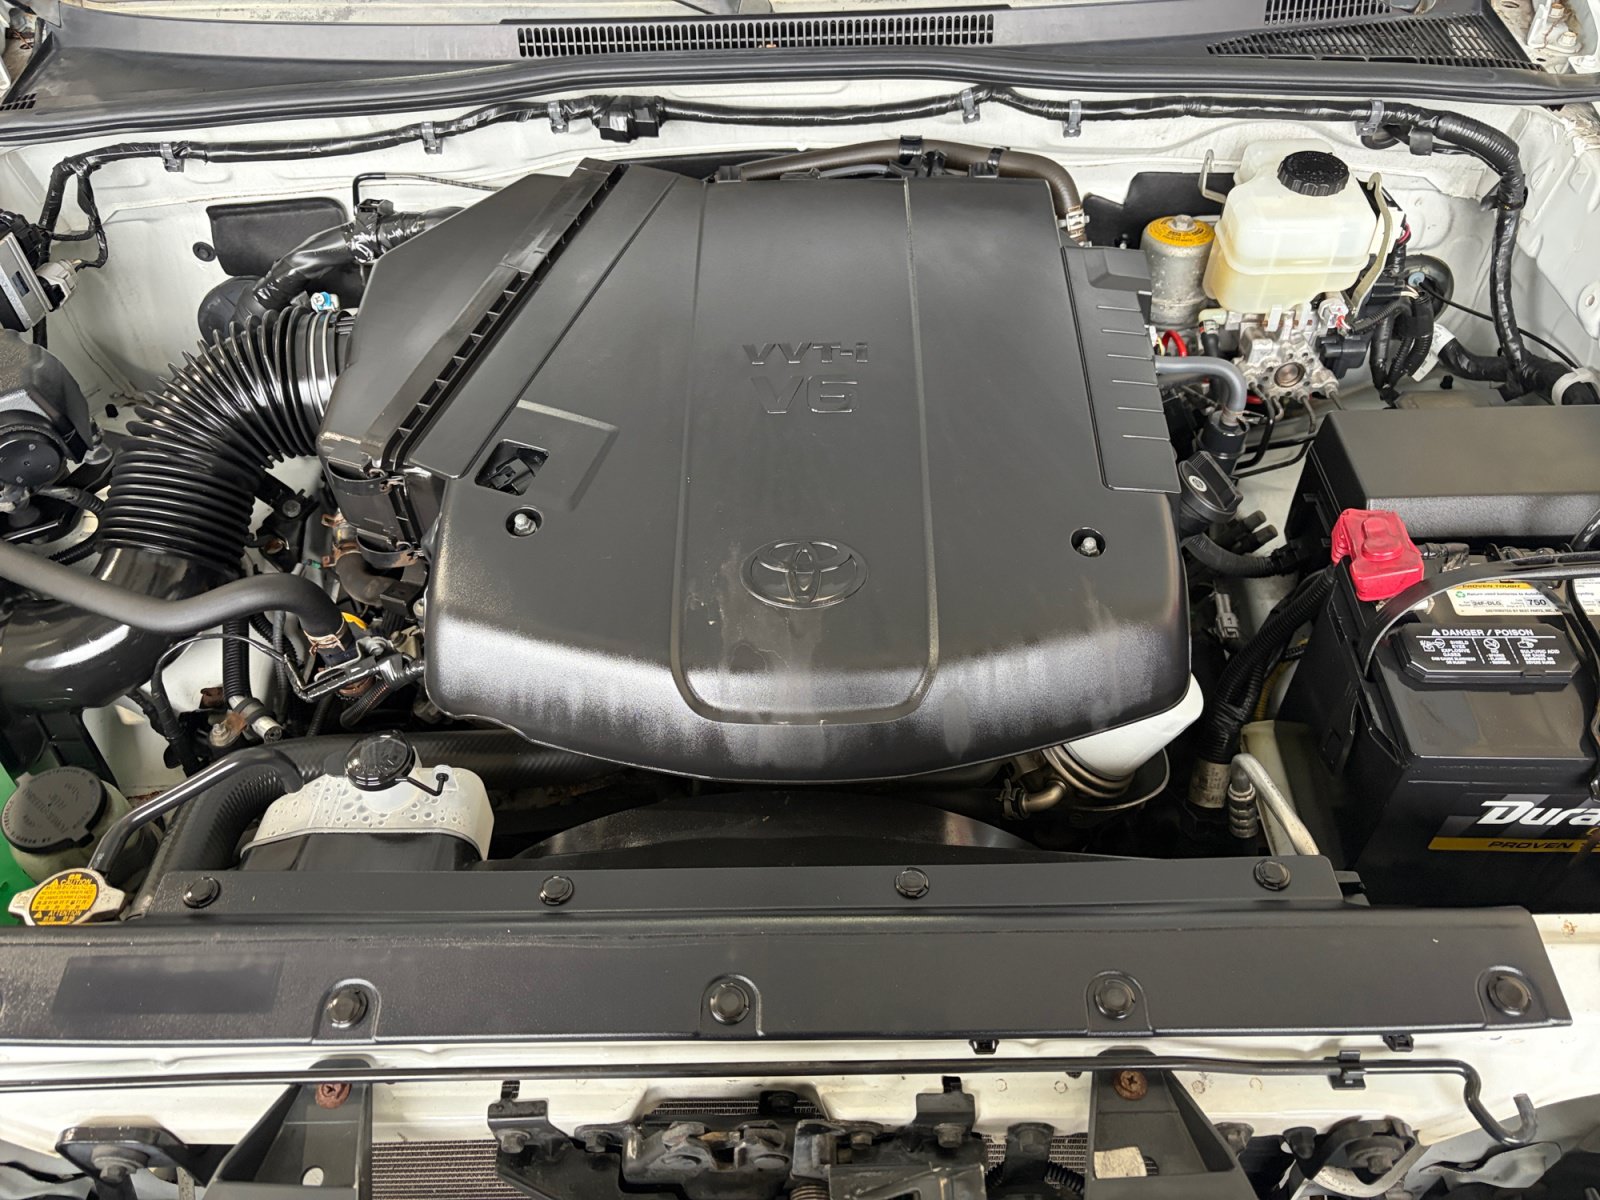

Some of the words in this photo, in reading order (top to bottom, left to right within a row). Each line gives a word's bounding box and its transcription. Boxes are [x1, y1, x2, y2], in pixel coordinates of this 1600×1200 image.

[750, 375, 859, 414] V6
[1526, 598, 1547, 606] 750
[1441, 628, 1484, 637] DANGER
[1486, 628, 1493, 637] /
[1494, 628, 1534, 637] POISON
[1477, 801, 1600, 825] Dura
[1488, 841, 1573, 849] PROVEN
[60, 878, 93, 886] CAUTION
[47, 909, 82, 918] ATTENTION
